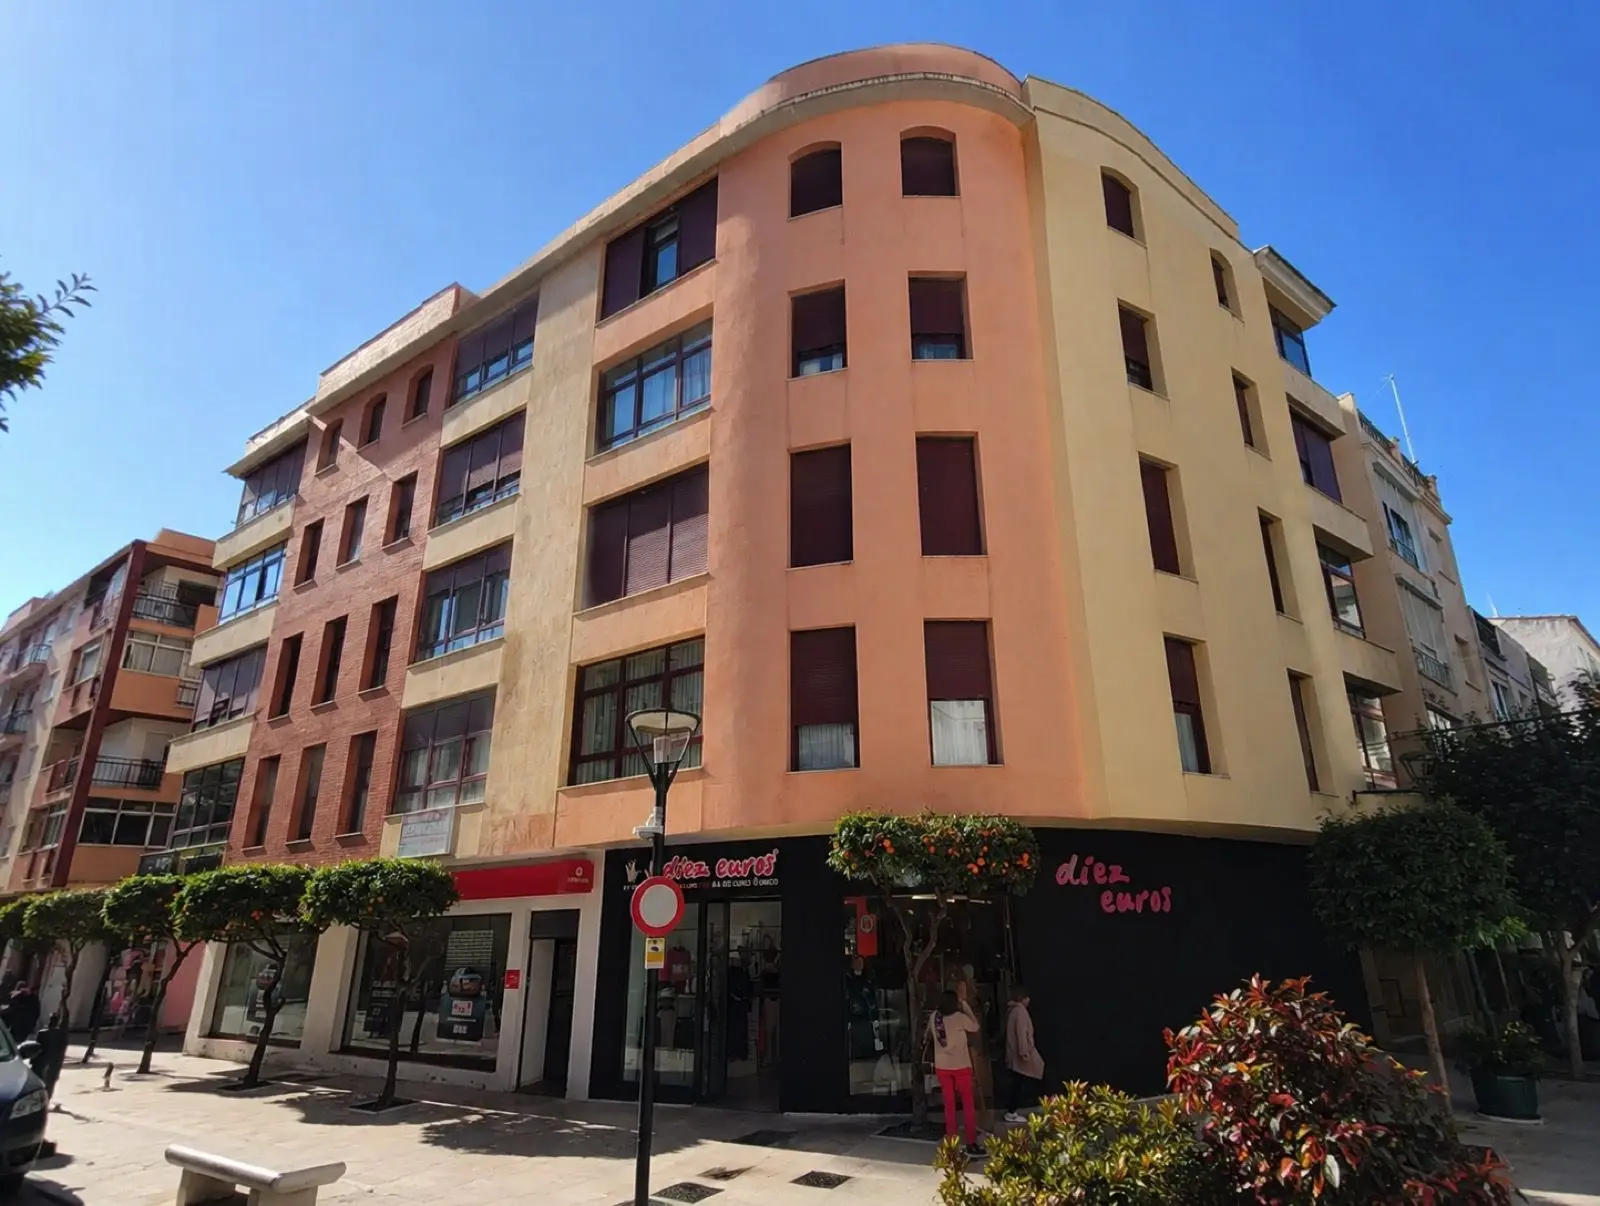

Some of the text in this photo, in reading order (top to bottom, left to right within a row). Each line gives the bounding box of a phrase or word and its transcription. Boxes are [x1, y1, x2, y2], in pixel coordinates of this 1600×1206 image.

[663, 853, 775, 880] diez euros
[1055, 854, 1130, 885] diez
[1100, 886, 1172, 913] euros
